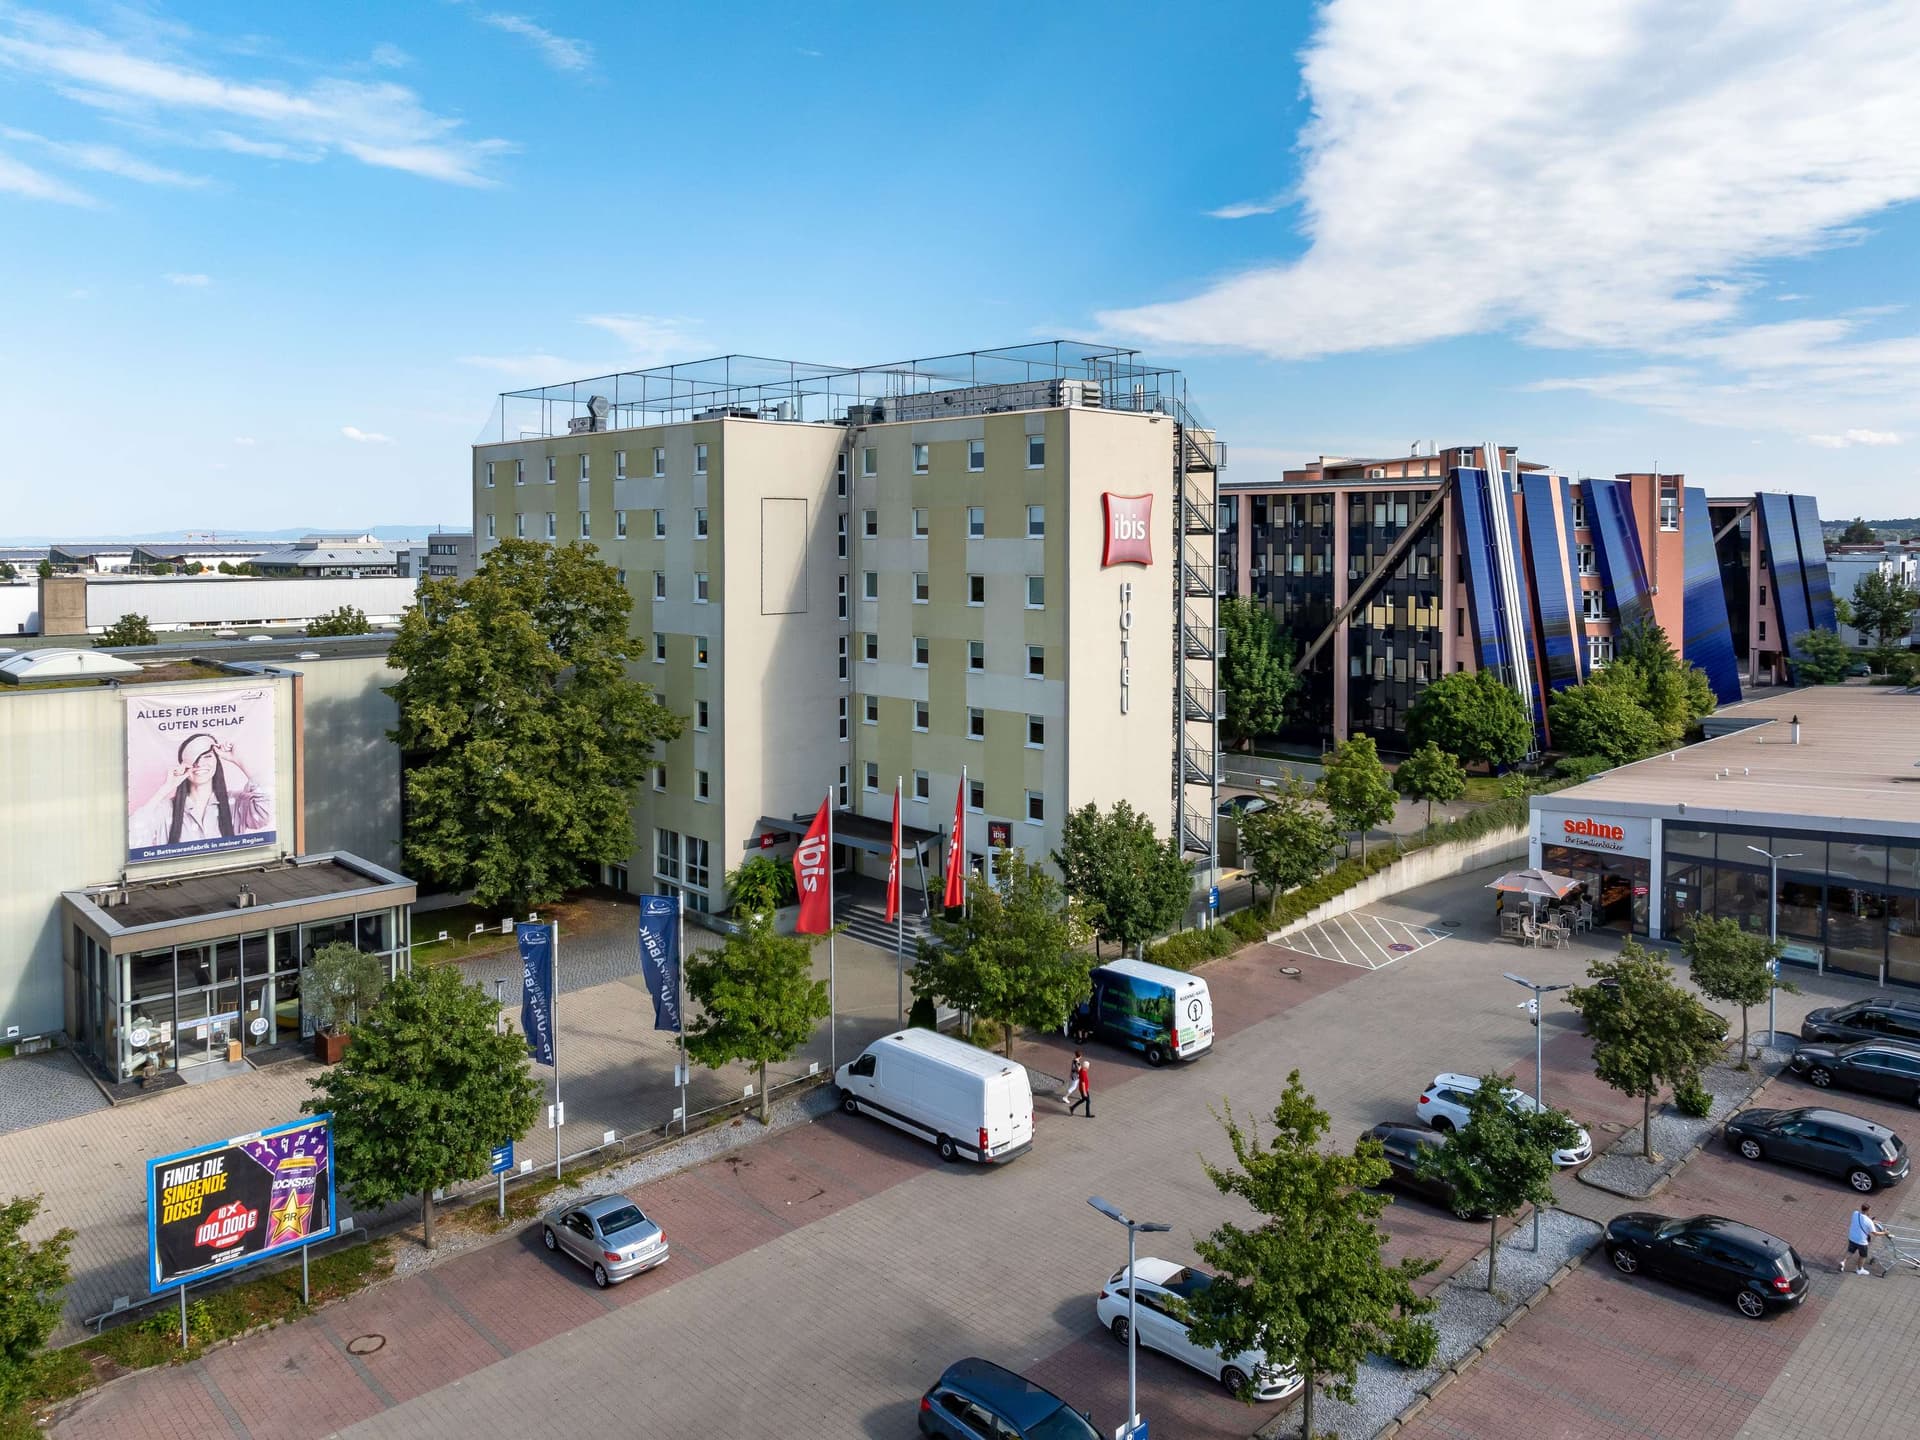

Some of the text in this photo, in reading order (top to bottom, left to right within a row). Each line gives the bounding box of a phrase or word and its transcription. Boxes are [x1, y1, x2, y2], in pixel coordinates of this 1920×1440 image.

[1113, 514, 1146, 540] ibis
[1120, 582, 1133, 715] HOTEL
[137, 704, 237, 719] ALLES FÜR IHREN
[158, 716, 245, 731] GUTEN SCHLAF
[993, 831, 1006, 840] ibis
[1531, 836, 1537, 844] 2
[1564, 817, 1624, 841] sehne
[143, 850, 155, 858] Die
[156, 842, 210, 856] Bettwarenfabrik
[242, 837, 264, 845] Region
[799, 834, 826, 892] ibis
[162, 1156, 225, 1189] FINDE DIE
[162, 1173, 229, 1207] SINGENDE
[163, 1197, 203, 1224] DOSE!
[198, 1213, 247, 1244] 100.000
